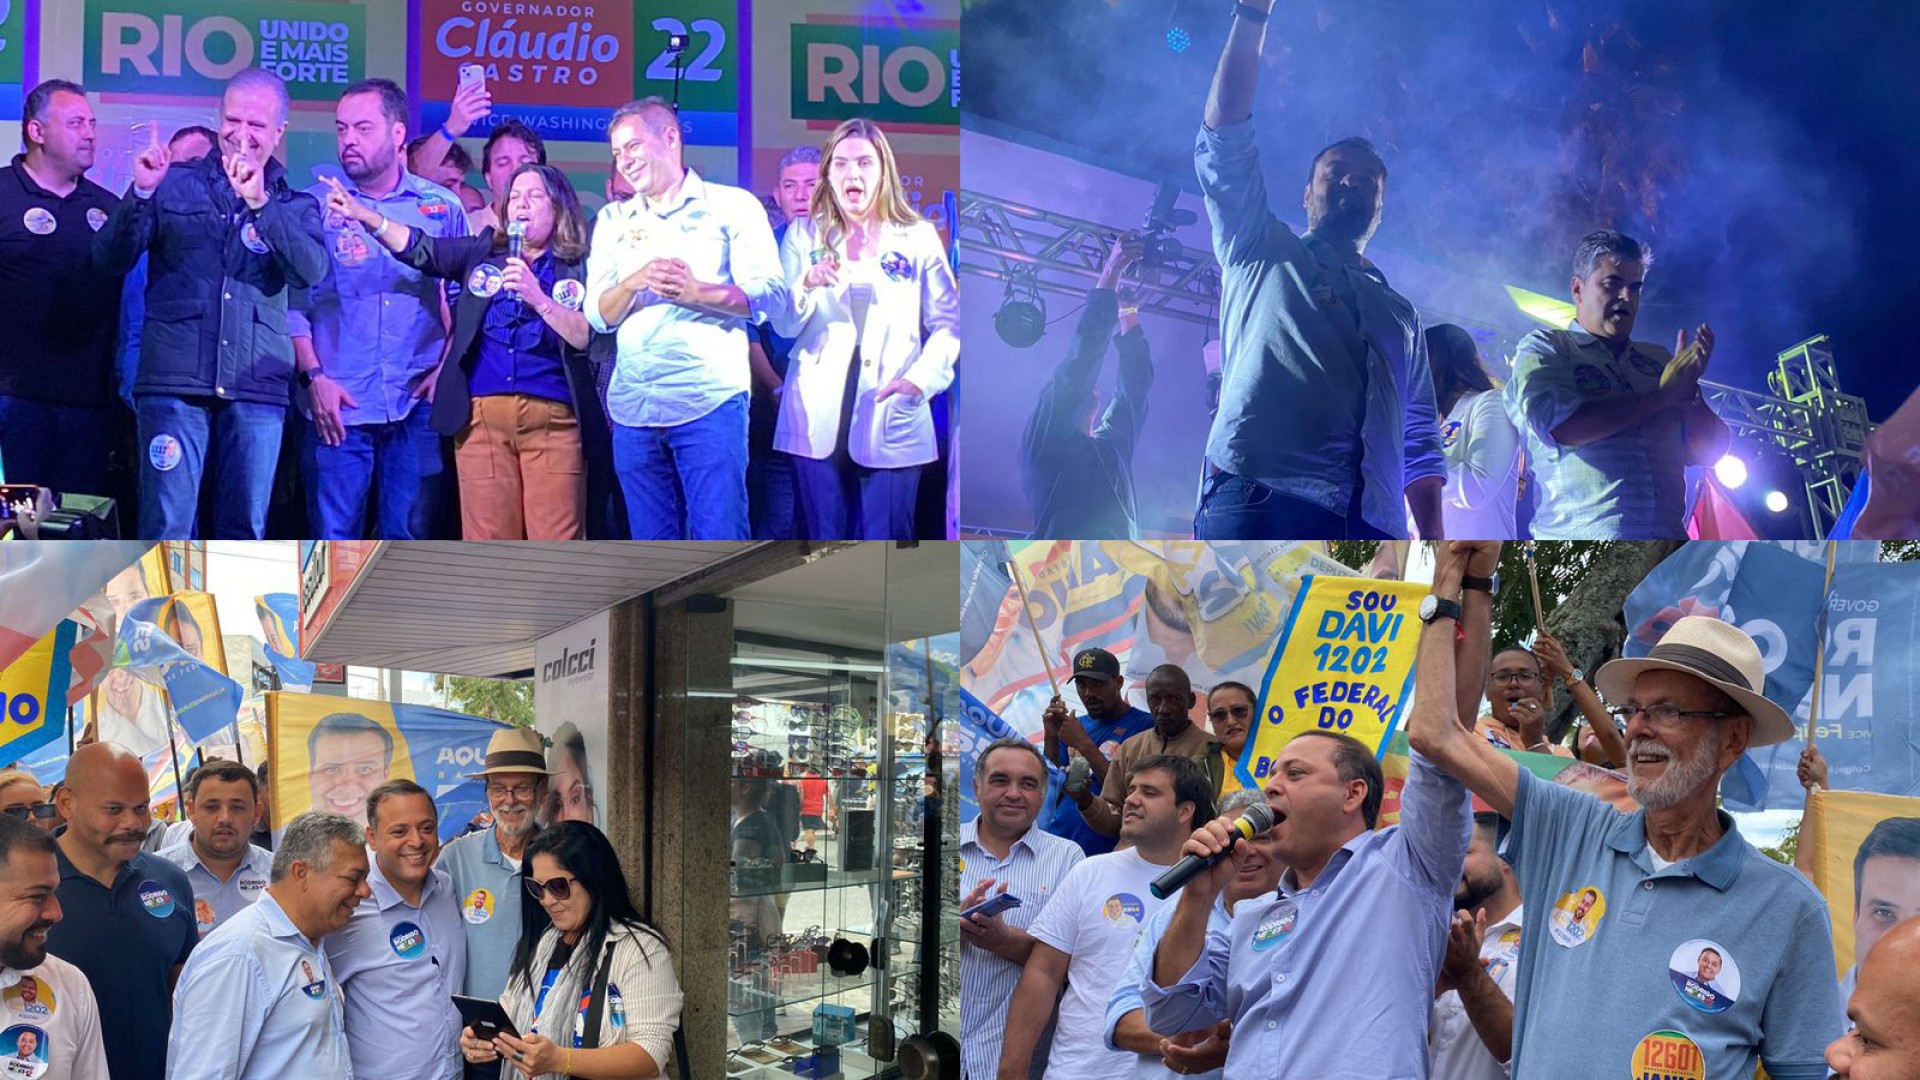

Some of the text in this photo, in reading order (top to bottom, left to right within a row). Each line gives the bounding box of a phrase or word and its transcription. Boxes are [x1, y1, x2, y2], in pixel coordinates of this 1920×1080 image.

[461, 1, 595, 18] GOVERNADOR
[101, 12, 254, 80] RIO
[259, 19, 349, 43] UNIDO
[436, 17, 620, 62] Cláudio
[261, 41, 349, 63] E MAIS
[646, 18, 726, 82] 22
[458, 62, 598, 86] ASTRO
[807, 43, 946, 107] RIO
[520, 114, 613, 131] WASHING
[1346, 591, 1397, 612] SOU
[1317, 609, 1404, 643] DAVI
[543, 638, 596, 683] colcci
[1313, 643, 1388, 674] 1202
[1268, 681, 1398, 725] O FEDERAL
[1318, 706, 1354, 729] DO
[24, 1003, 48, 1015] 1202
[1643, 1039, 1699, 1072] 12601
